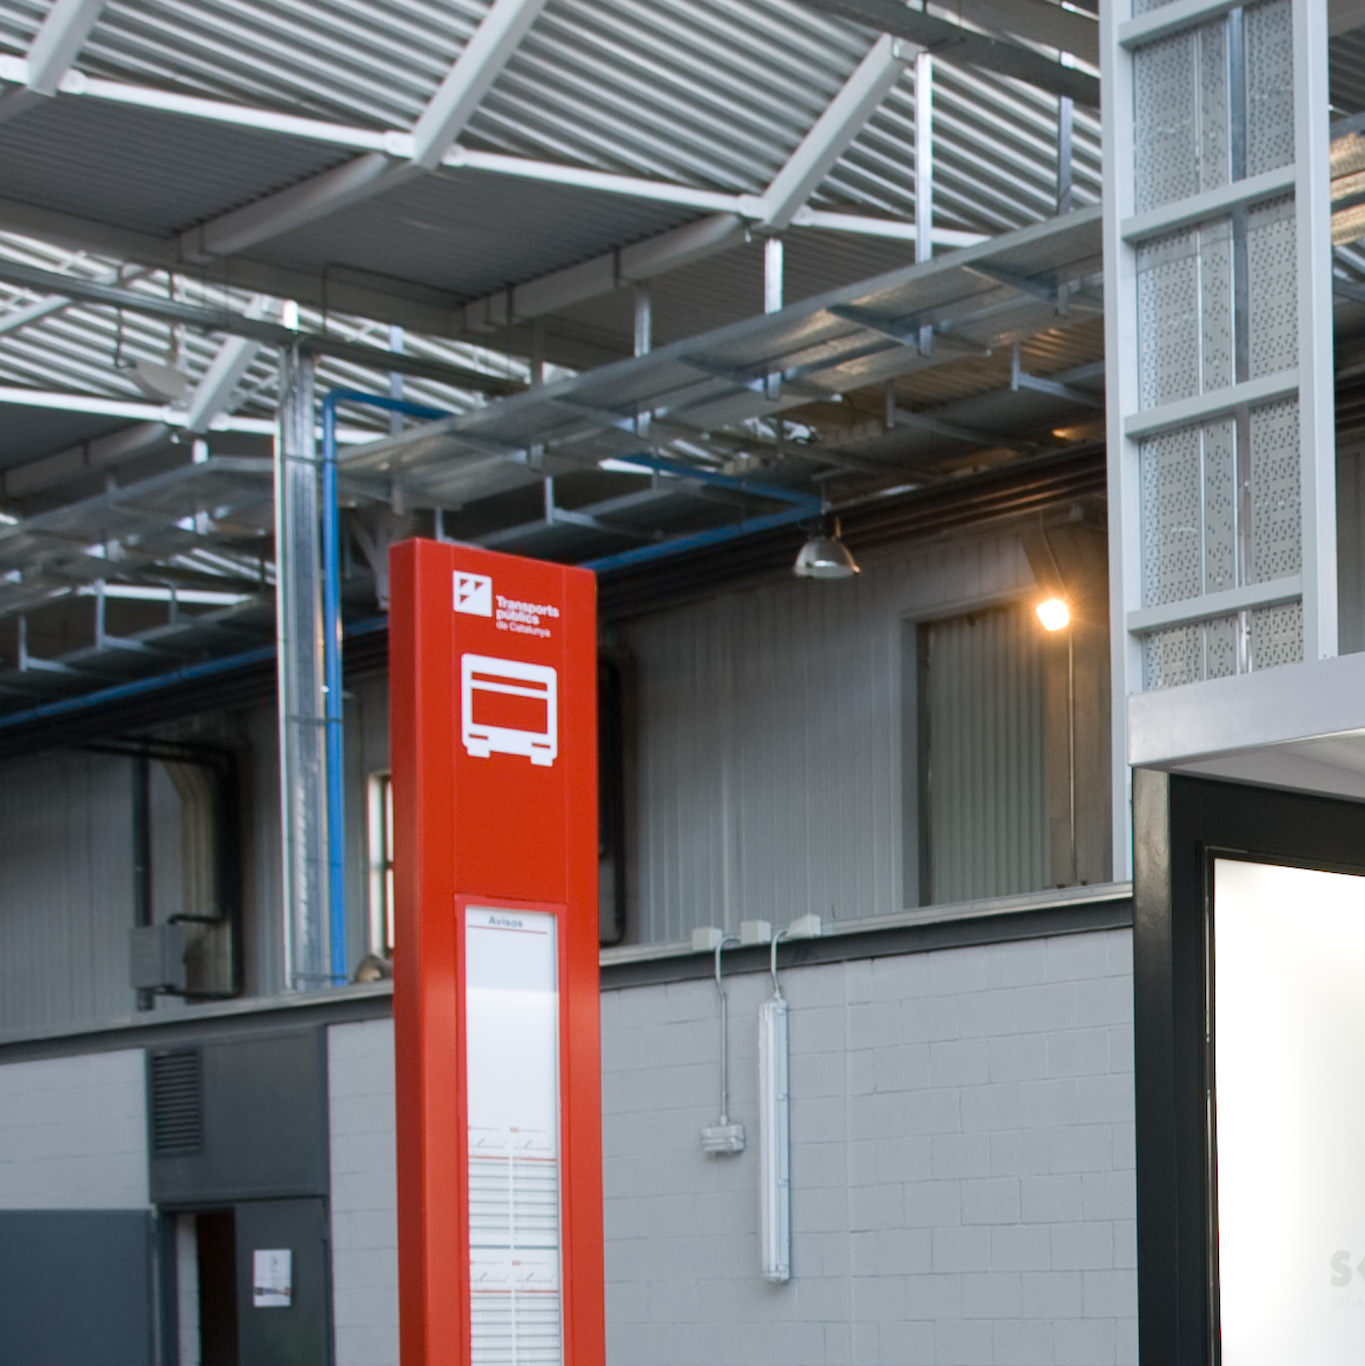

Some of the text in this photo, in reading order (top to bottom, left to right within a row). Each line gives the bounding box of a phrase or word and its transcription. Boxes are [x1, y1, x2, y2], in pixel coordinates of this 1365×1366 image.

[495, 594, 560, 619] Transports
[495, 608, 540, 625] públics
[495, 620, 551, 638] de Catalunya
[488, 915, 524, 928] Avisos
